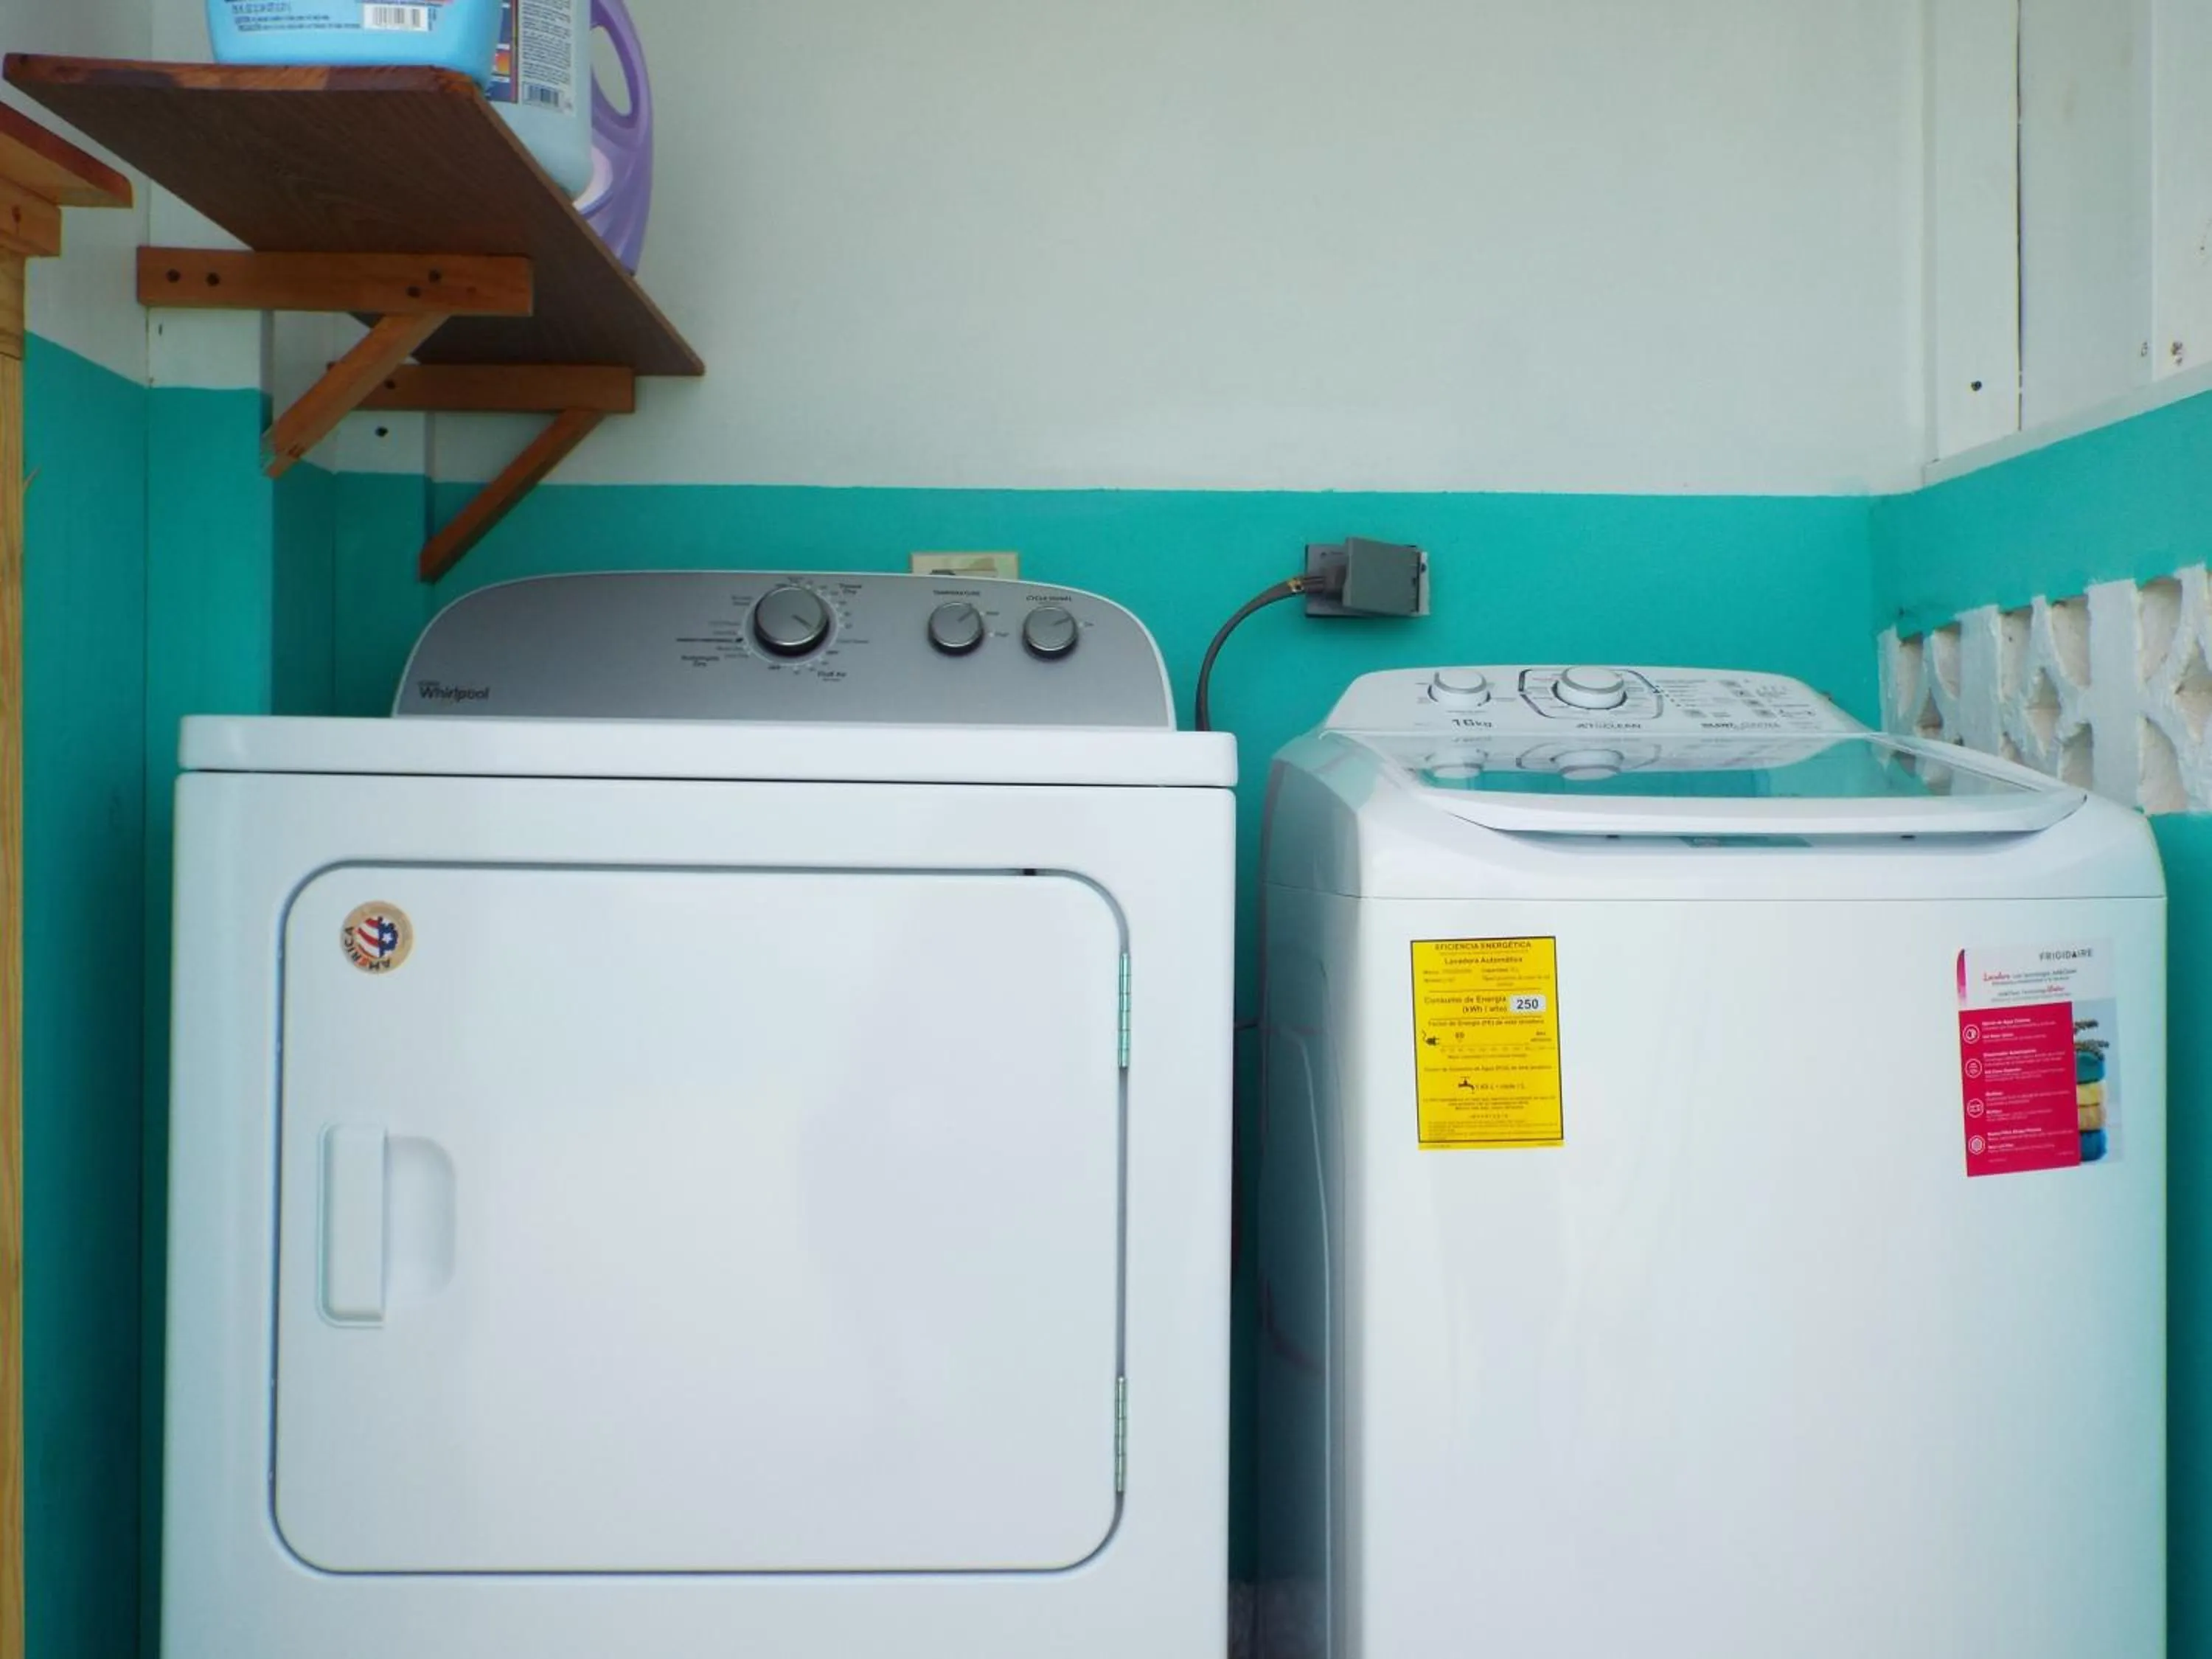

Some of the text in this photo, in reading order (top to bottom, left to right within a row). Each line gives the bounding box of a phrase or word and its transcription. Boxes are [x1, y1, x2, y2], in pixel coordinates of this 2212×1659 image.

[419, 685, 490, 703] Whirlpool
[1434, 942, 1479, 950] EFICIENCIA
[2039, 947, 2093, 961] FRIGIDAIRE
[1516, 998, 1539, 1009] 250
